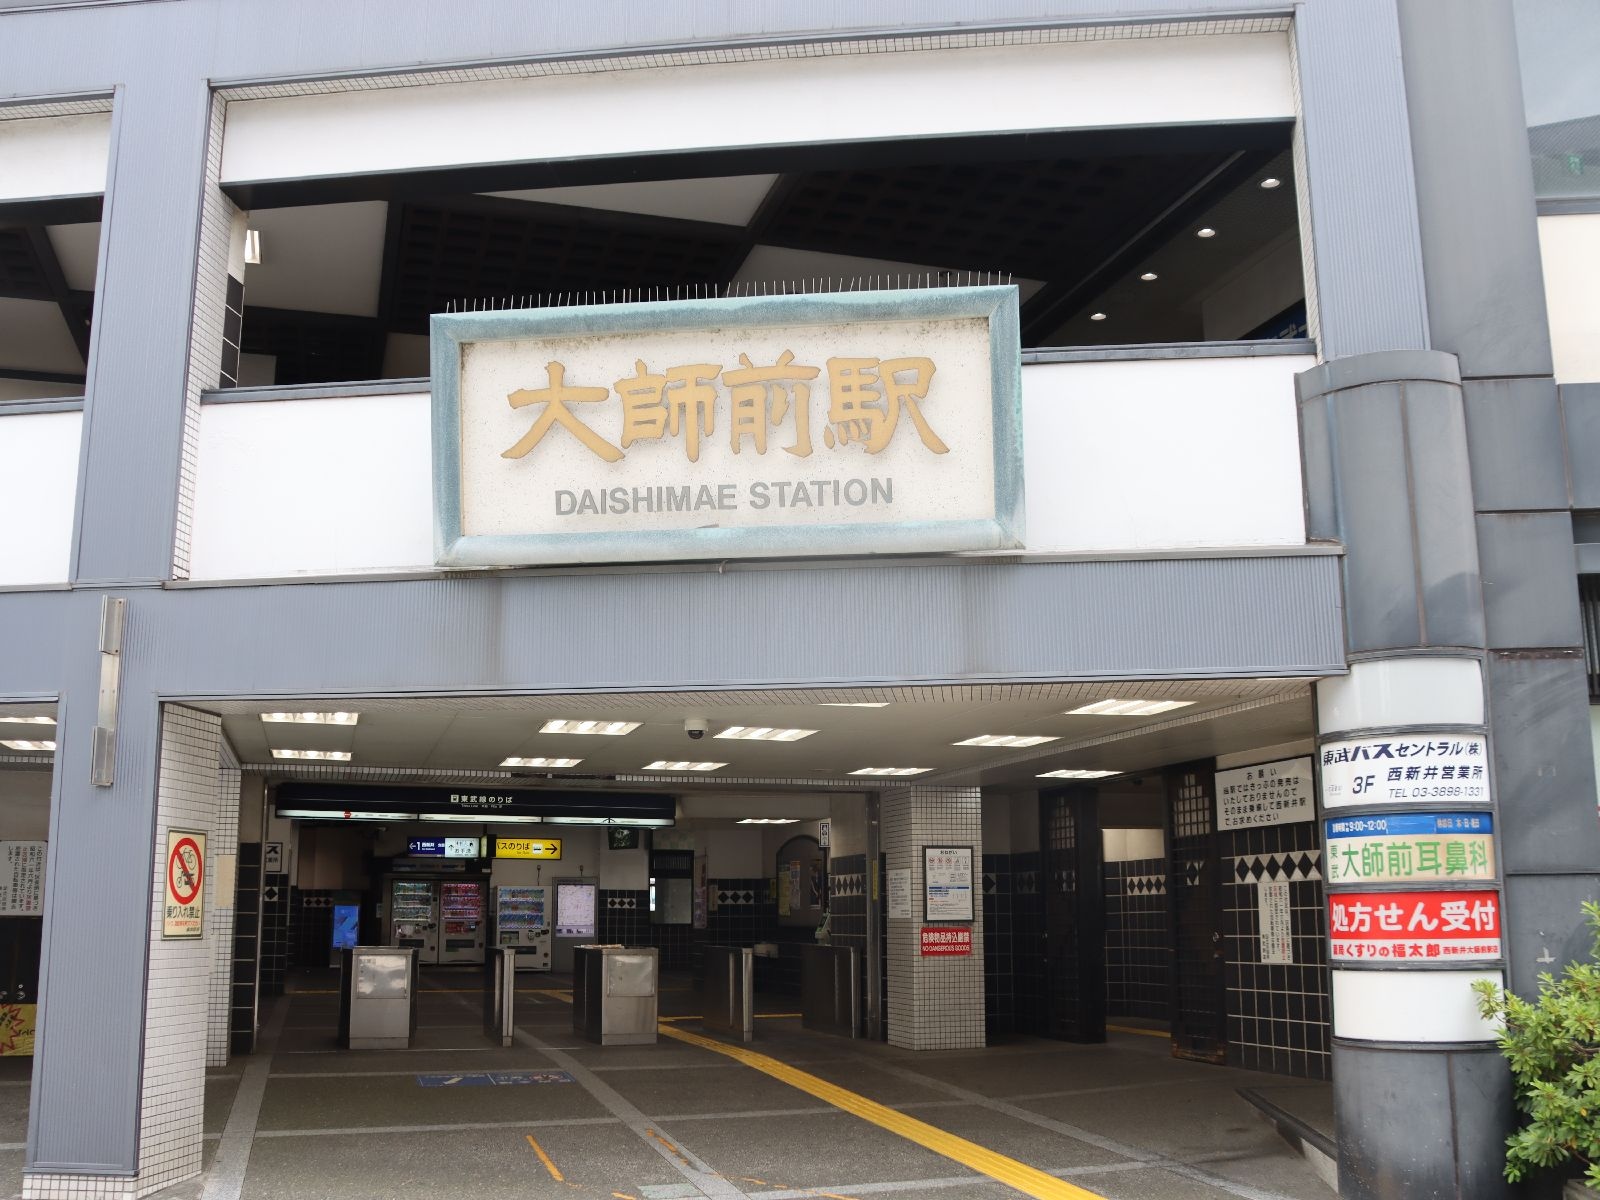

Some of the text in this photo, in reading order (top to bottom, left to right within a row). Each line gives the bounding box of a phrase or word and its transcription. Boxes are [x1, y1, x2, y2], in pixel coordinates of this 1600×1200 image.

[500, 348, 950, 463] 大師前駅
[554, 477, 894, 516] DAISHIMAE STATION
[1352, 774, 1376, 795] 3F
[1387, 765, 1484, 782] 西新井営業所
[1389, 788, 1408, 798] TEL
[1342, 840, 1488, 878] 大師前耳鼻科
[1332, 899, 1496, 933] 処方せん受付
